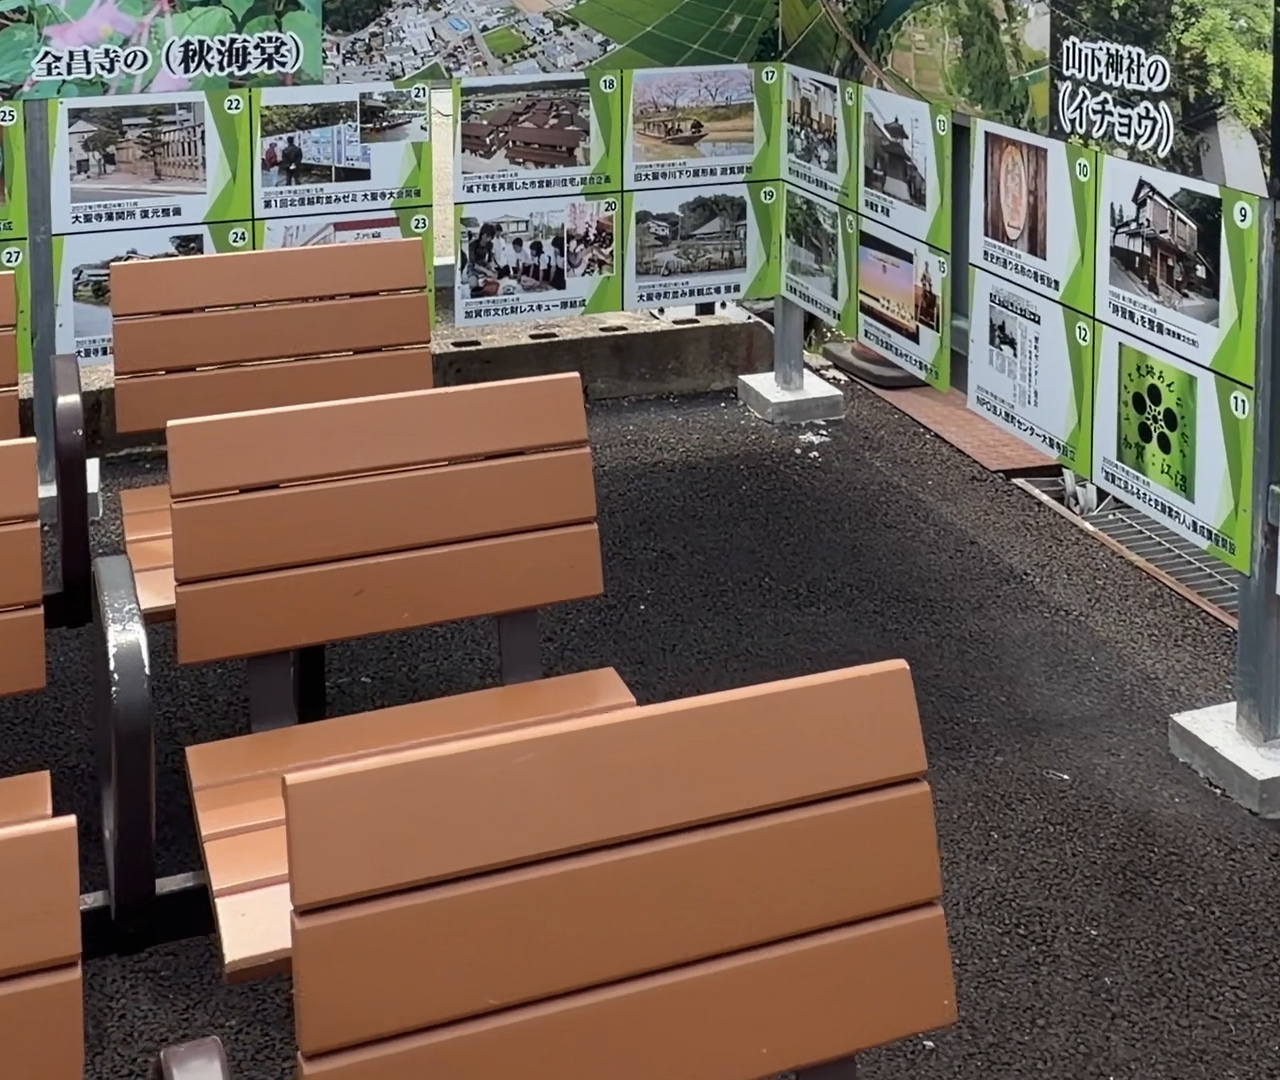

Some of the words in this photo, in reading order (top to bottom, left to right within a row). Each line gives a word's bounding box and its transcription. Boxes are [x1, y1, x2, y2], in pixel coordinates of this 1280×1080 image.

[1064, 40, 1167, 87] 山下神社の
[764, 70, 776, 81] 17
[602, 79, 615, 90] 18
[413, 87, 426, 98] 21
[227, 98, 241, 110] 22
[0, 110, 15, 122] 25
[1078, 163, 1089, 177] 10
[763, 190, 774, 201] 19
[604, 201, 617, 212] 20
[1239, 206, 1247, 223] 9
[414, 218, 427, 229] 23
[232, 231, 246, 243] 24
[5, 251, 20, 263] 27
[937, 262, 946, 274] 15
[1078, 326, 1089, 342] 12
[1232, 395, 1247, 415] 11
